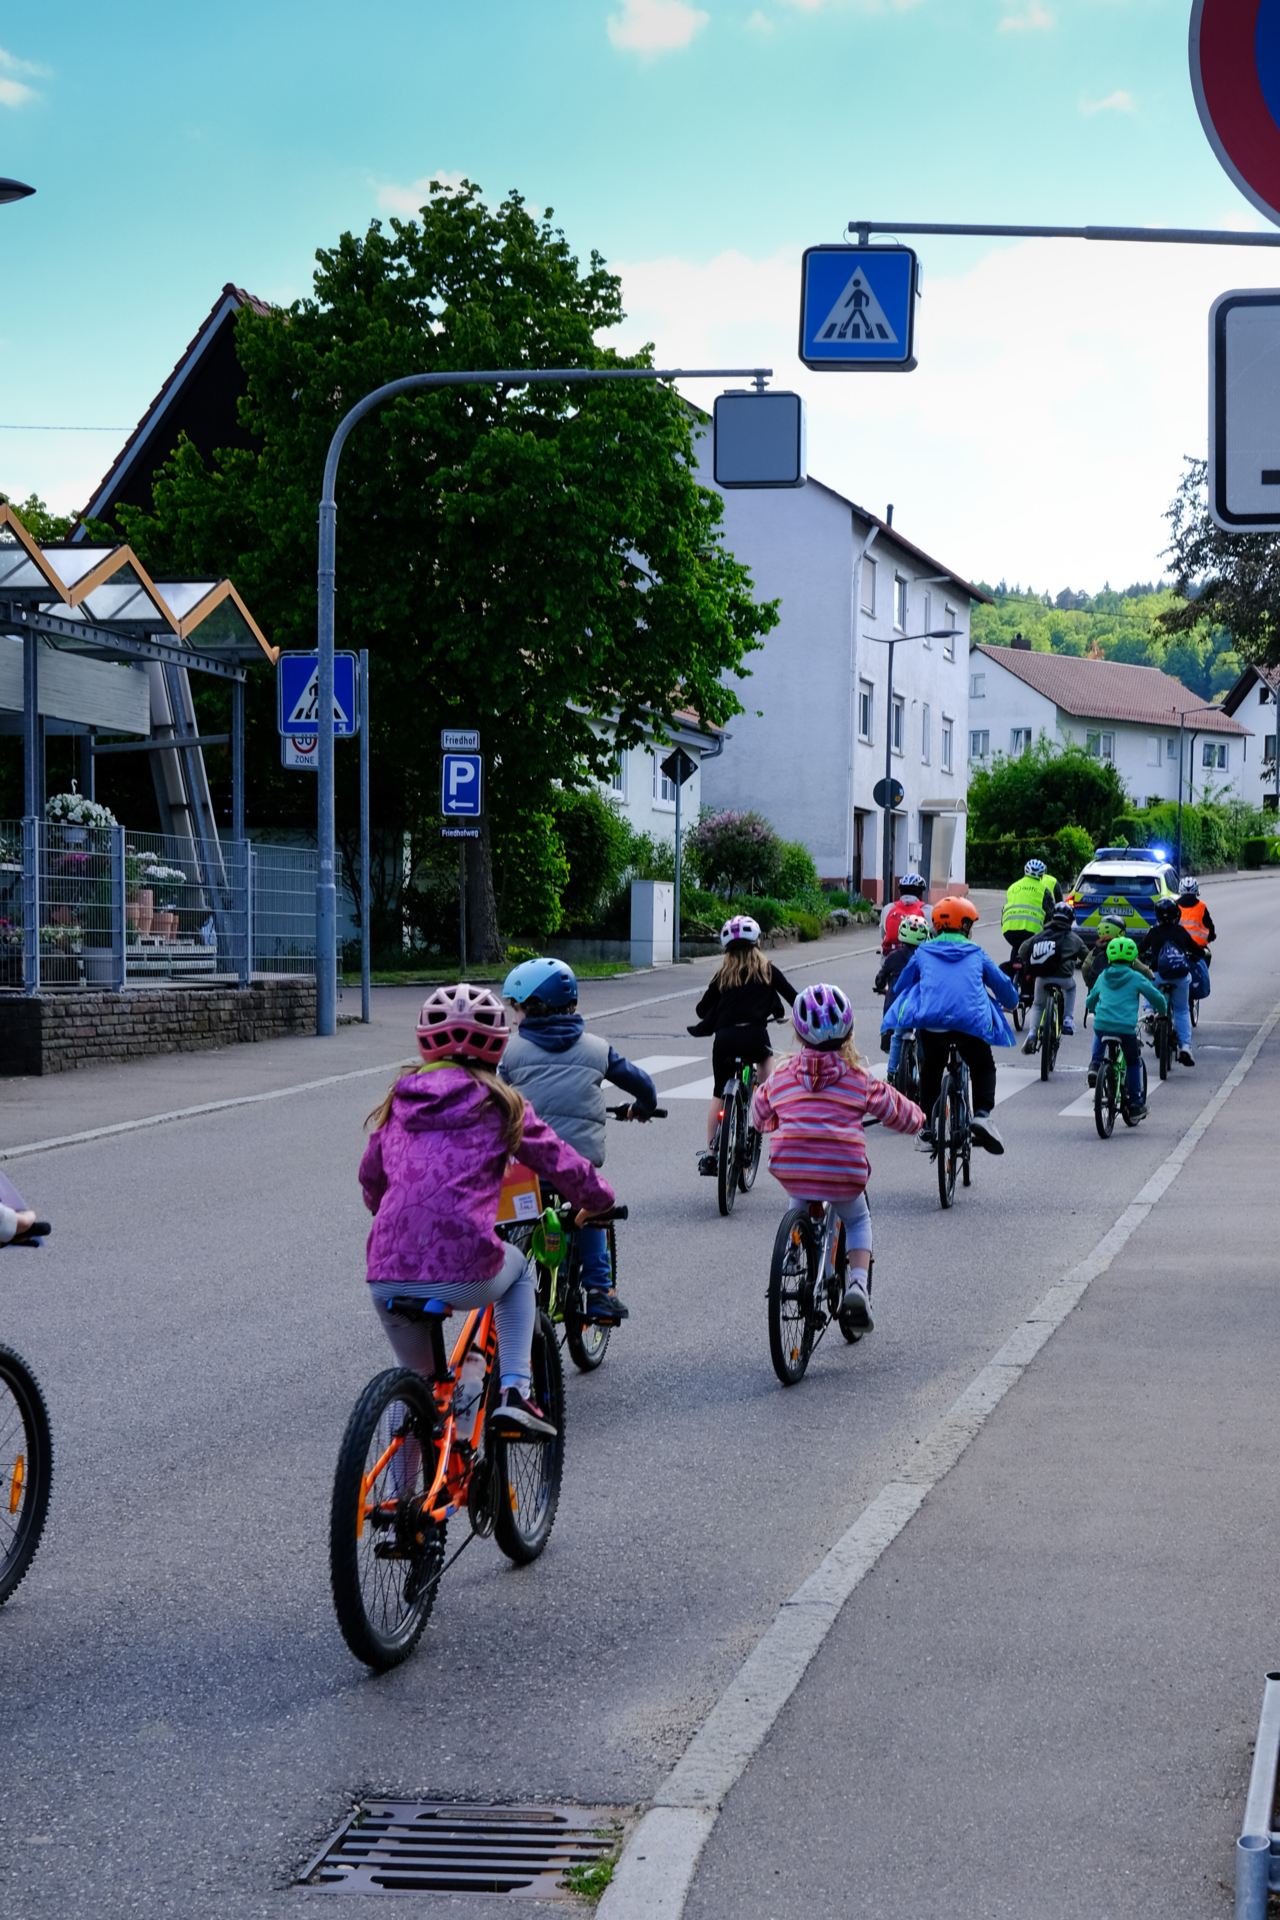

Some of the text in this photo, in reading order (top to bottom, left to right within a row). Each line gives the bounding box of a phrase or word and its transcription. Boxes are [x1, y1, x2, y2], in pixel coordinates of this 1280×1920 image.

[445, 735, 476, 745] Friedhof
[295, 755, 315, 764] ZONE
[449, 761, 475, 795] P
[1033, 940, 1056, 958] NIKE
